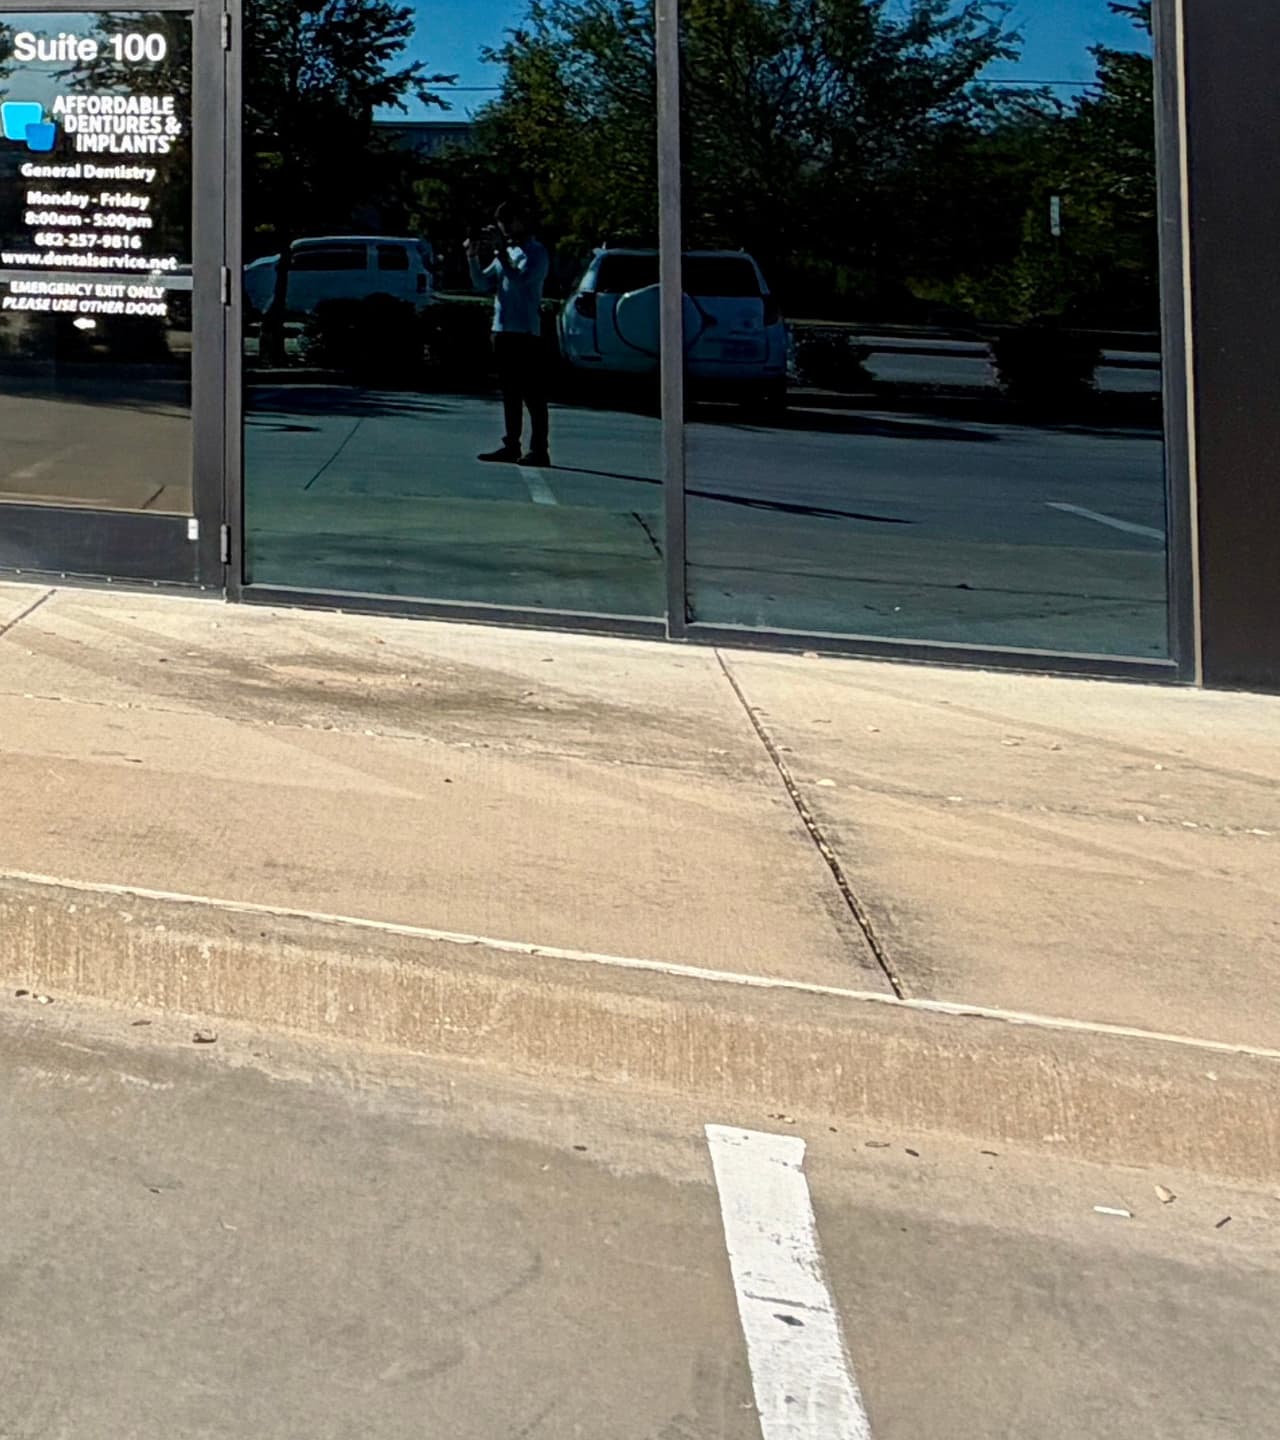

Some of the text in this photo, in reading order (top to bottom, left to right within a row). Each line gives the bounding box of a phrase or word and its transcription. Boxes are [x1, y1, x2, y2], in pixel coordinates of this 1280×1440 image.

[14, 32, 167, 62] Suite 100
[52, 95, 175, 114] AFFORDABLE
[64, 115, 182, 135] DENTURES &
[21, 163, 156, 182] General Dentistry
[27, 191, 89, 209] Monday
[100, 193, 150, 210] Friday
[25, 211, 82, 226] 8:00am
[93, 213, 153, 230] 5:00pm
[34, 232, 142, 248] 682-257-9816
[1, 251, 178, 270] www.dentalservice.net
[10, 281, 165, 299] EMERGENCY EXIT ONLY
[2, 297, 168, 316] PLEASE USE OTHER DOOR
